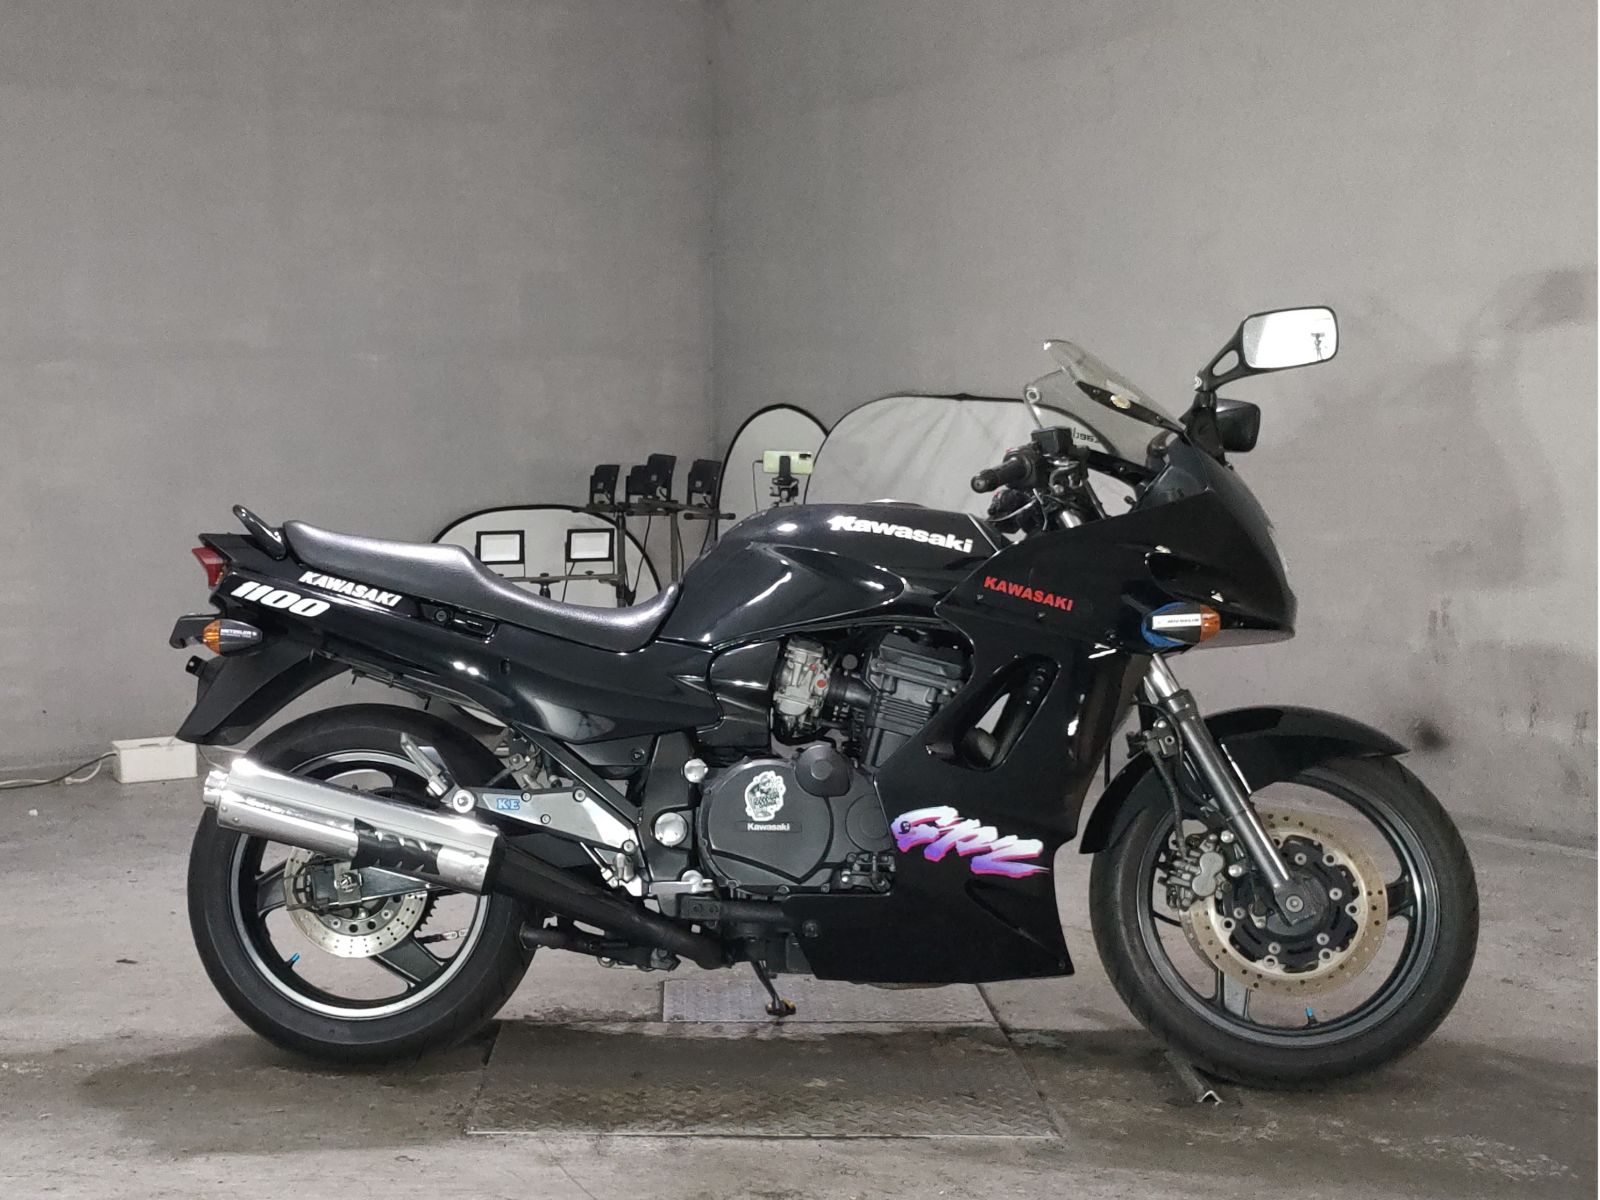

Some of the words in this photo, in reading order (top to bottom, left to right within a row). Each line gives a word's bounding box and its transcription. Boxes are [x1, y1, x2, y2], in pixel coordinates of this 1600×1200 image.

[827, 515, 973, 553] Kawasaki
[230, 581, 331, 617] 1100
[298, 571, 403, 607] KAWASAKI
[983, 576, 1073, 611] KAWASAKI
[496, 798, 520, 810] KE
[747, 823, 790, 831] Kawasaki
